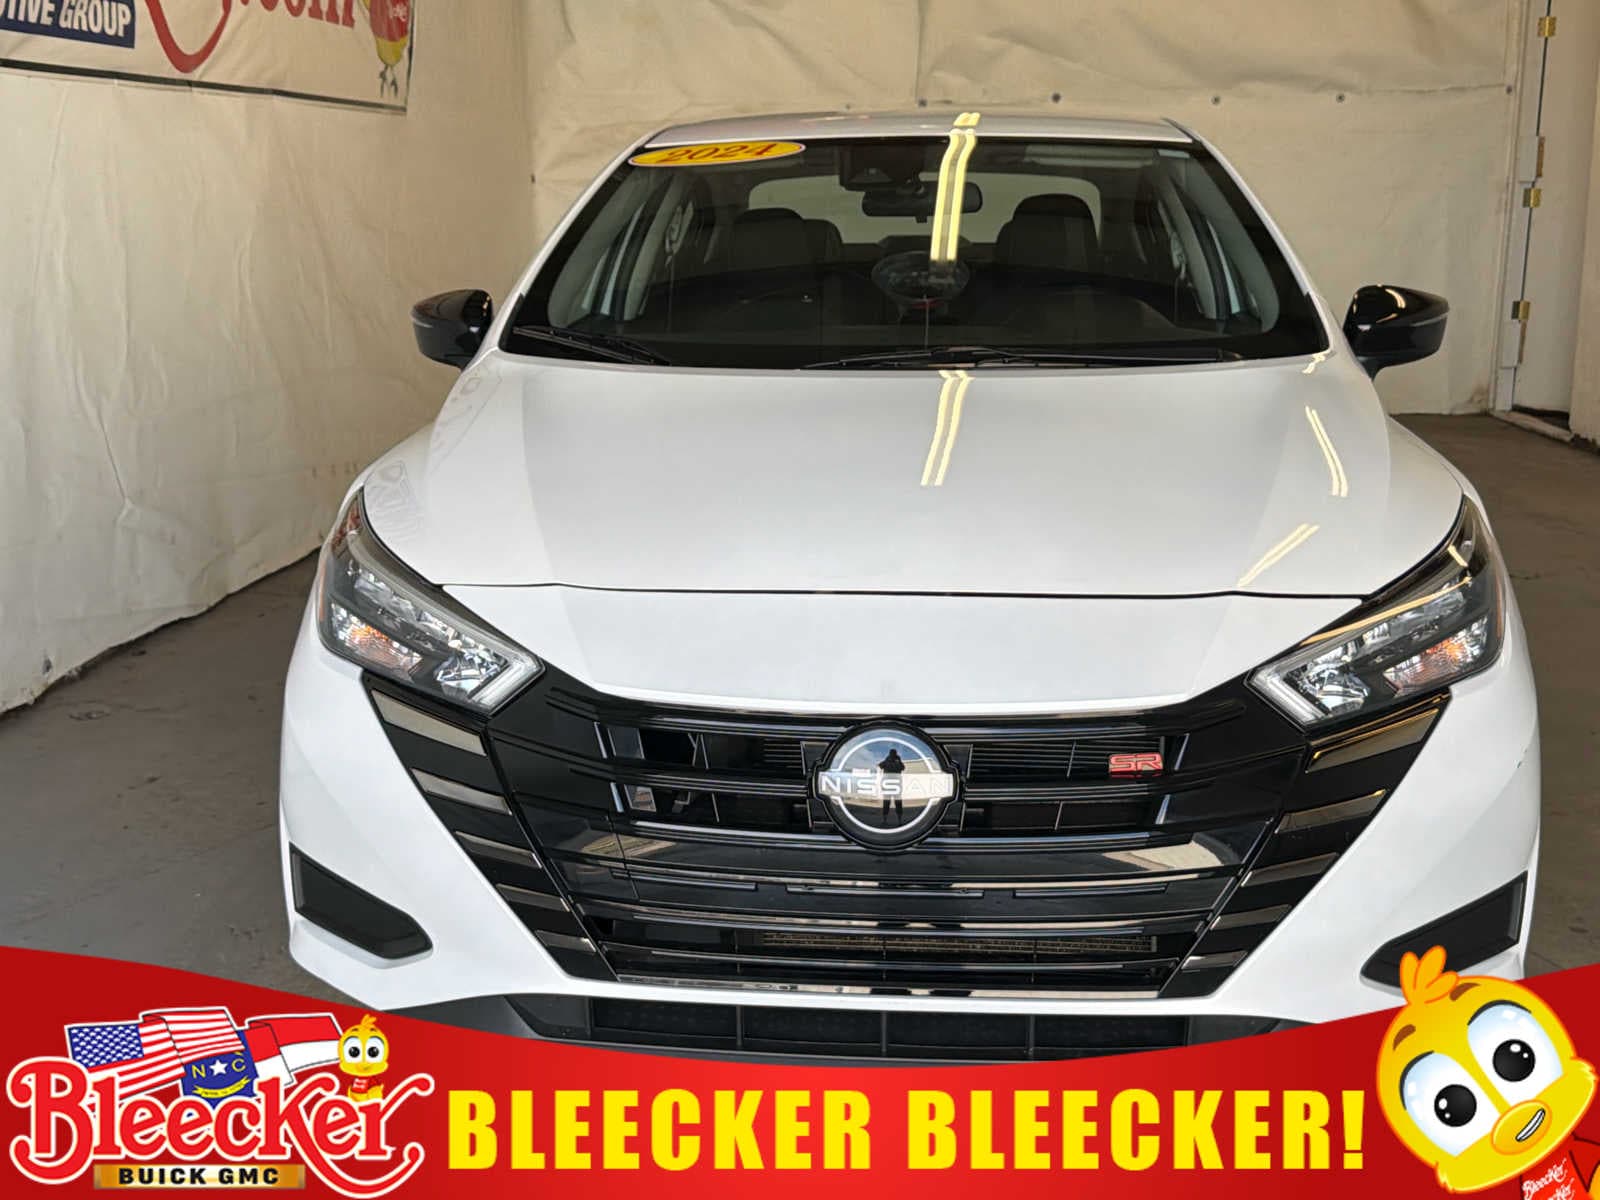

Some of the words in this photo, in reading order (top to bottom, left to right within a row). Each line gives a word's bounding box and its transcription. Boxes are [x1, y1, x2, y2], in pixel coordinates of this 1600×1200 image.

[0, 0, 55, 26] TIVE
[58, 0, 132, 37] GROUP
[655, 143, 777, 163] 2024
[1109, 752, 1163, 772] SR
[820, 774, 952, 796] NISSAN
